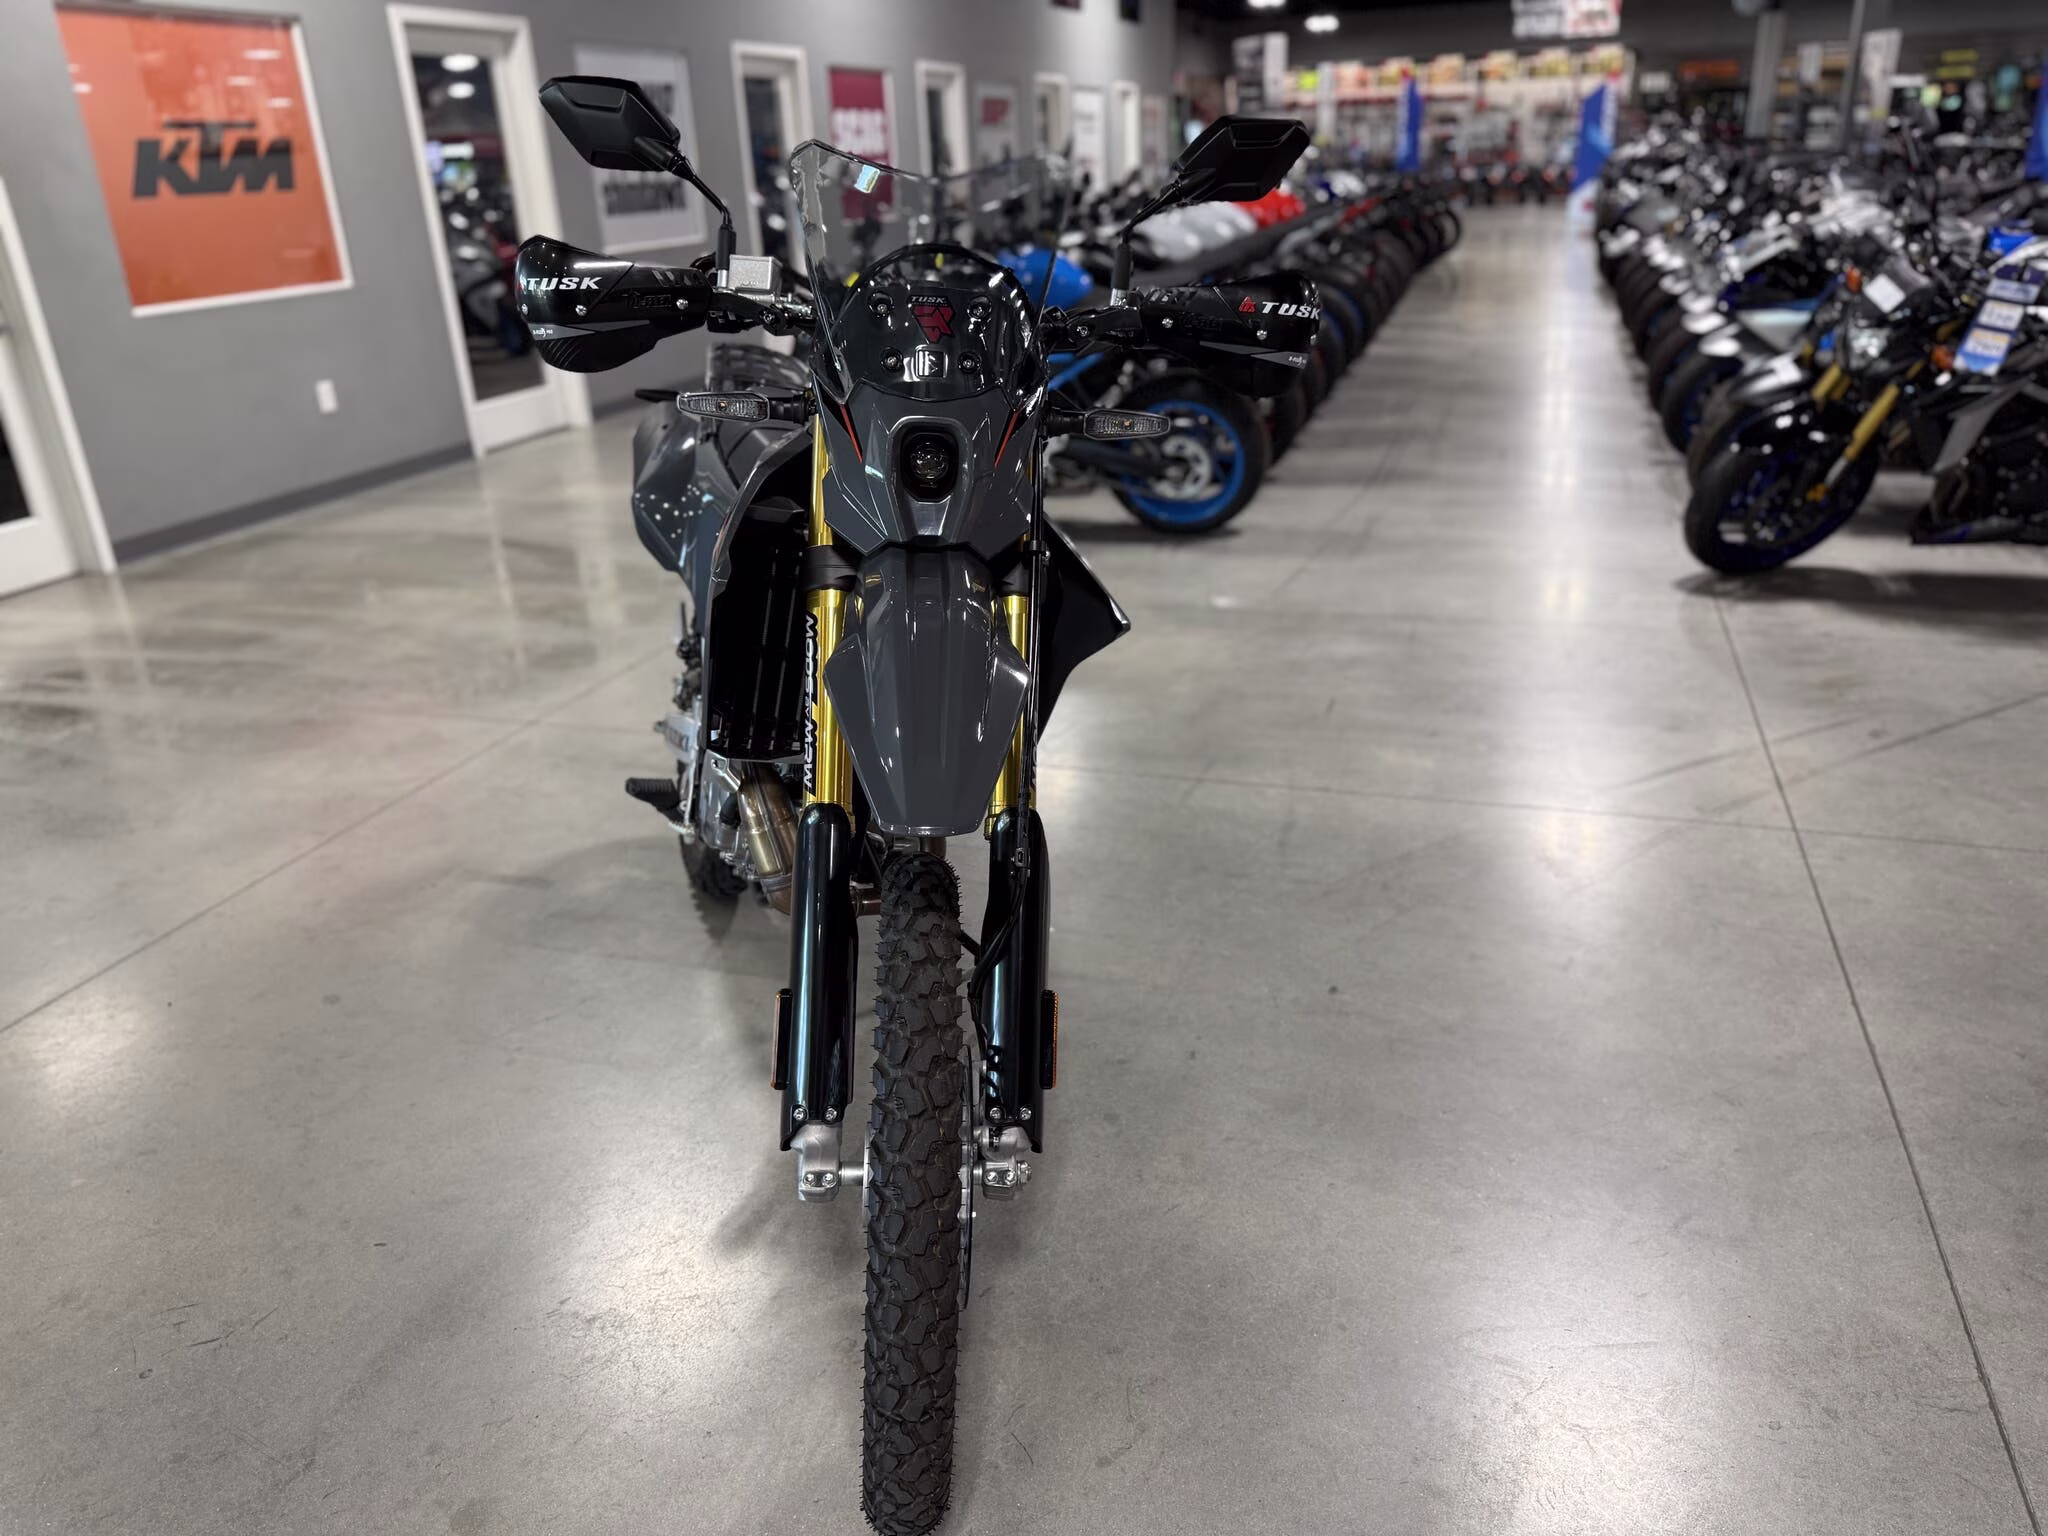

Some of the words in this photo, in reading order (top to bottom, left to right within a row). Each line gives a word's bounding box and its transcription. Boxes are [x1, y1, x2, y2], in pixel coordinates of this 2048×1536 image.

[133, 120, 295, 199] KTM
[527, 277, 602, 290] TUSK
[1261, 301, 1321, 320] TUSK
